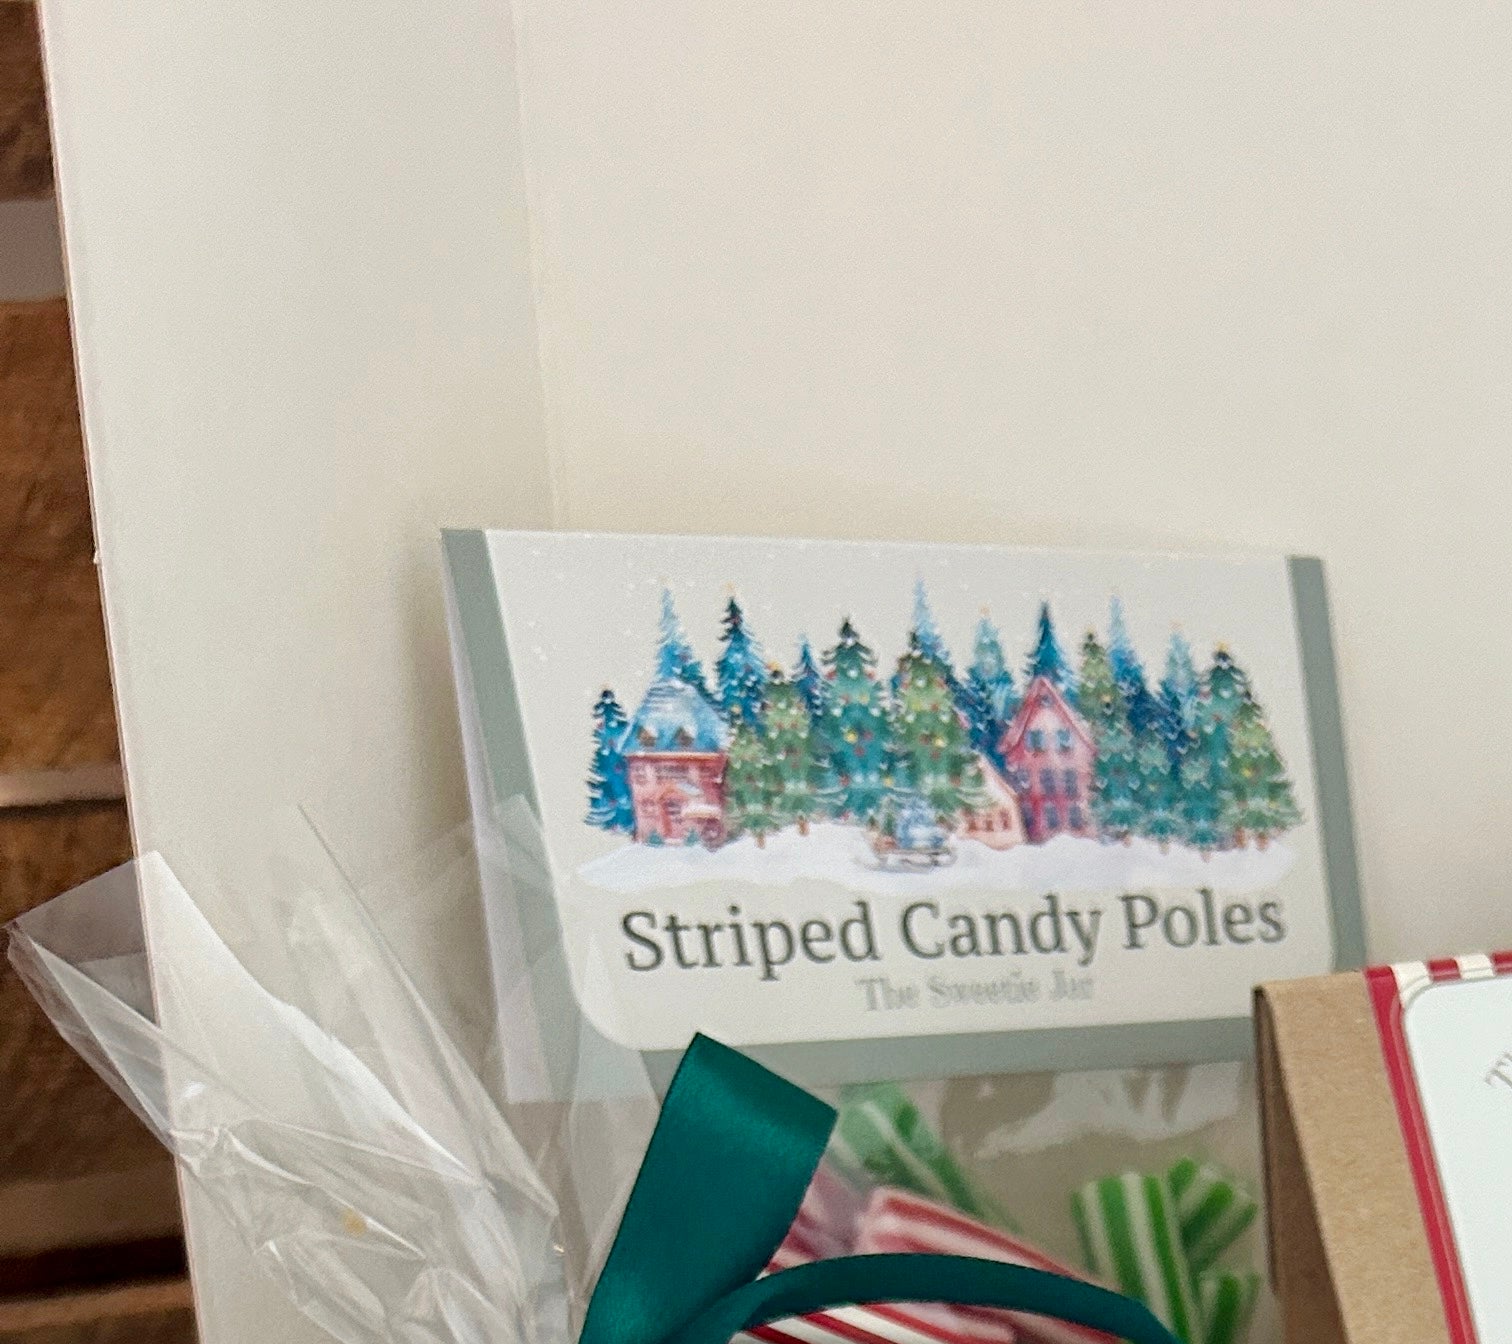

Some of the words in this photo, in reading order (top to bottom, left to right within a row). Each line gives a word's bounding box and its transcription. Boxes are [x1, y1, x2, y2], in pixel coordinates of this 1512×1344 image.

[621, 901, 880, 980] Striped
[900, 893, 1103, 966] Candy
[1120, 887, 1286, 950] Poles
[859, 976, 917, 1011] The
[928, 971, 1039, 1006] Sweetie
[1050, 968, 1096, 1002] Jar
